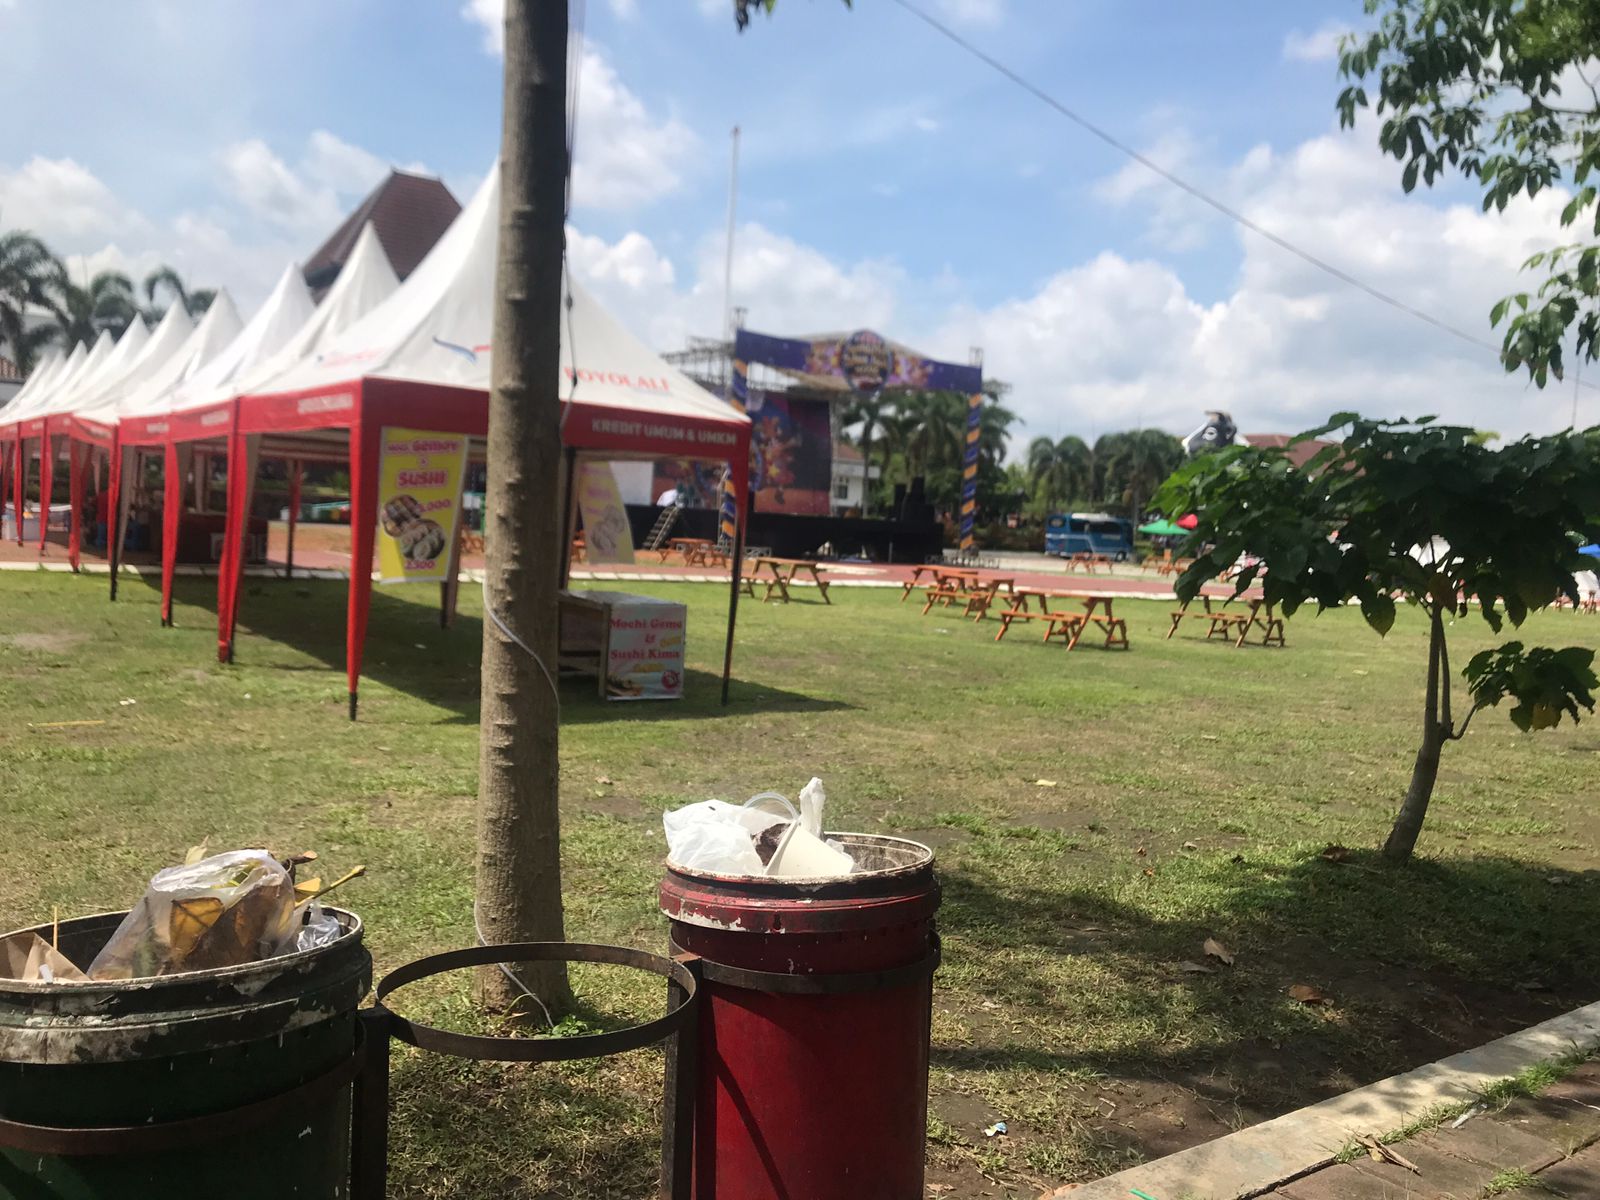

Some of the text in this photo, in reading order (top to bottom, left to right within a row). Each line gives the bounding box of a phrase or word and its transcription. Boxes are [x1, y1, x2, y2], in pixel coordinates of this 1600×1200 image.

[592, 418, 737, 446] KREDIT UMUM & UMKM
[398, 470, 445, 487] SUSHI
[610, 649, 644, 660] Sushi
